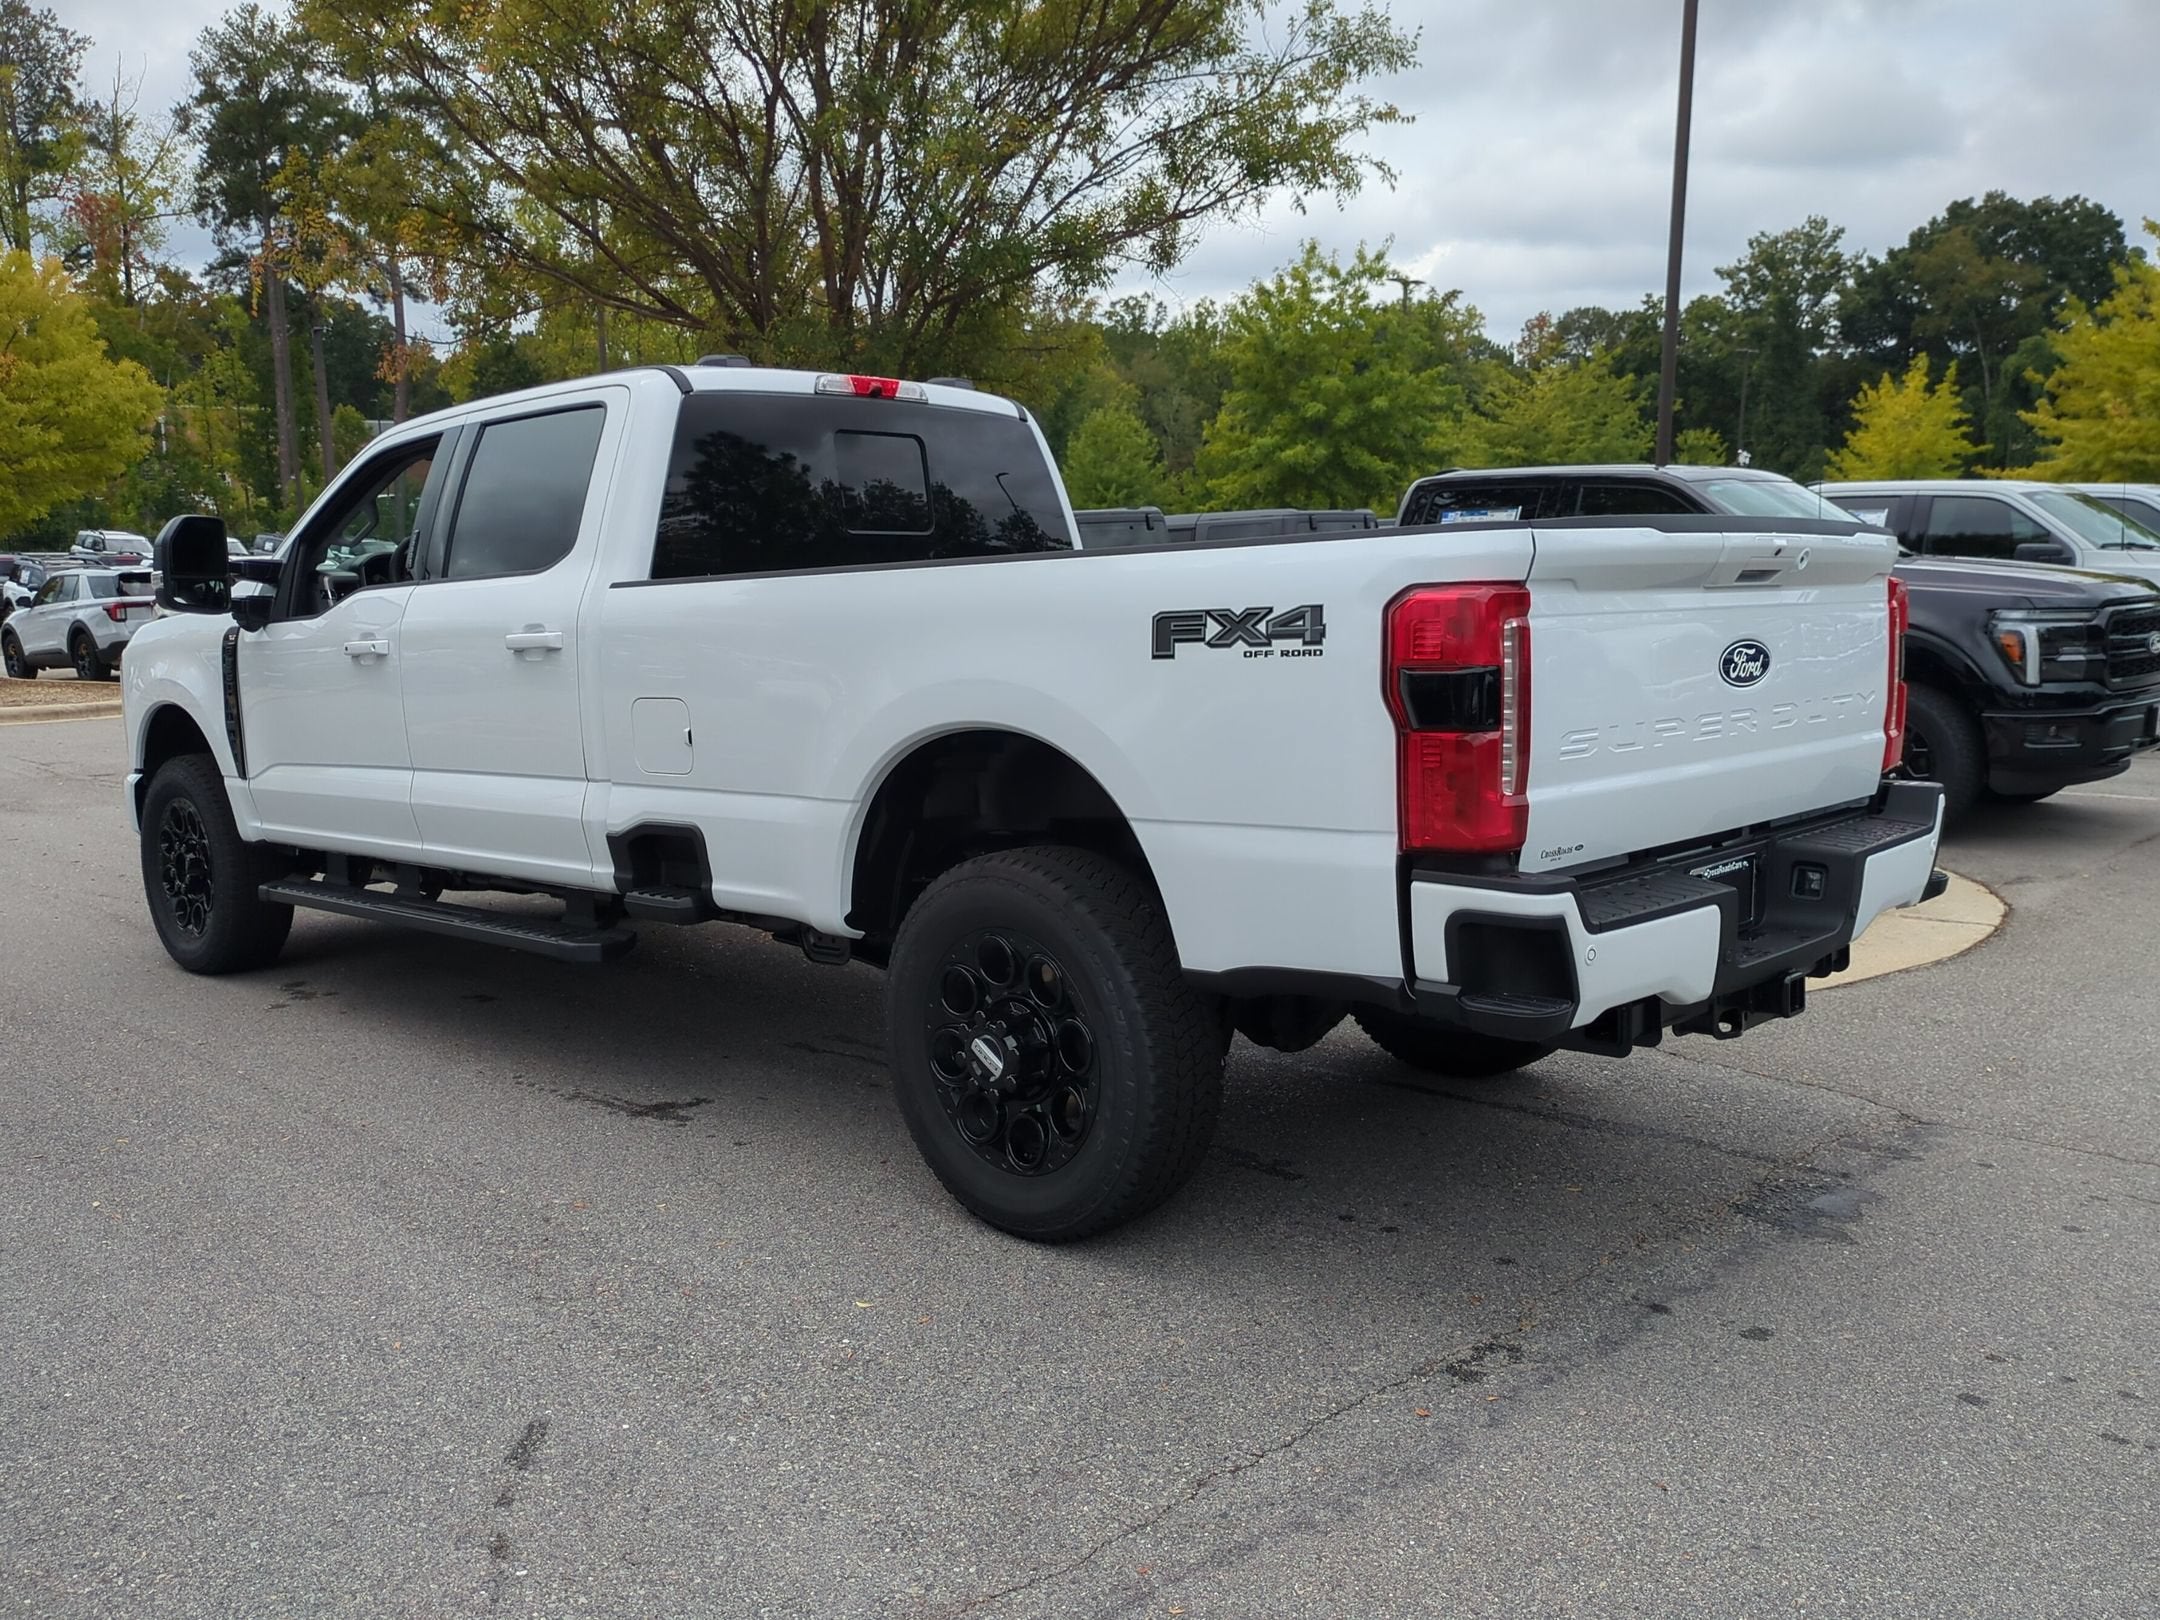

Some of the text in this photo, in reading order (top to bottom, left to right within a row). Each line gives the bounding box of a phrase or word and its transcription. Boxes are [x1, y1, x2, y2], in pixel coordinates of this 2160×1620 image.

[1152, 604, 1326, 660] FX4
[1243, 648, 1323, 659] OFF ROAD
[1729, 647, 1764, 679] Ford
[1559, 690, 1876, 761] SUPER DUTY
